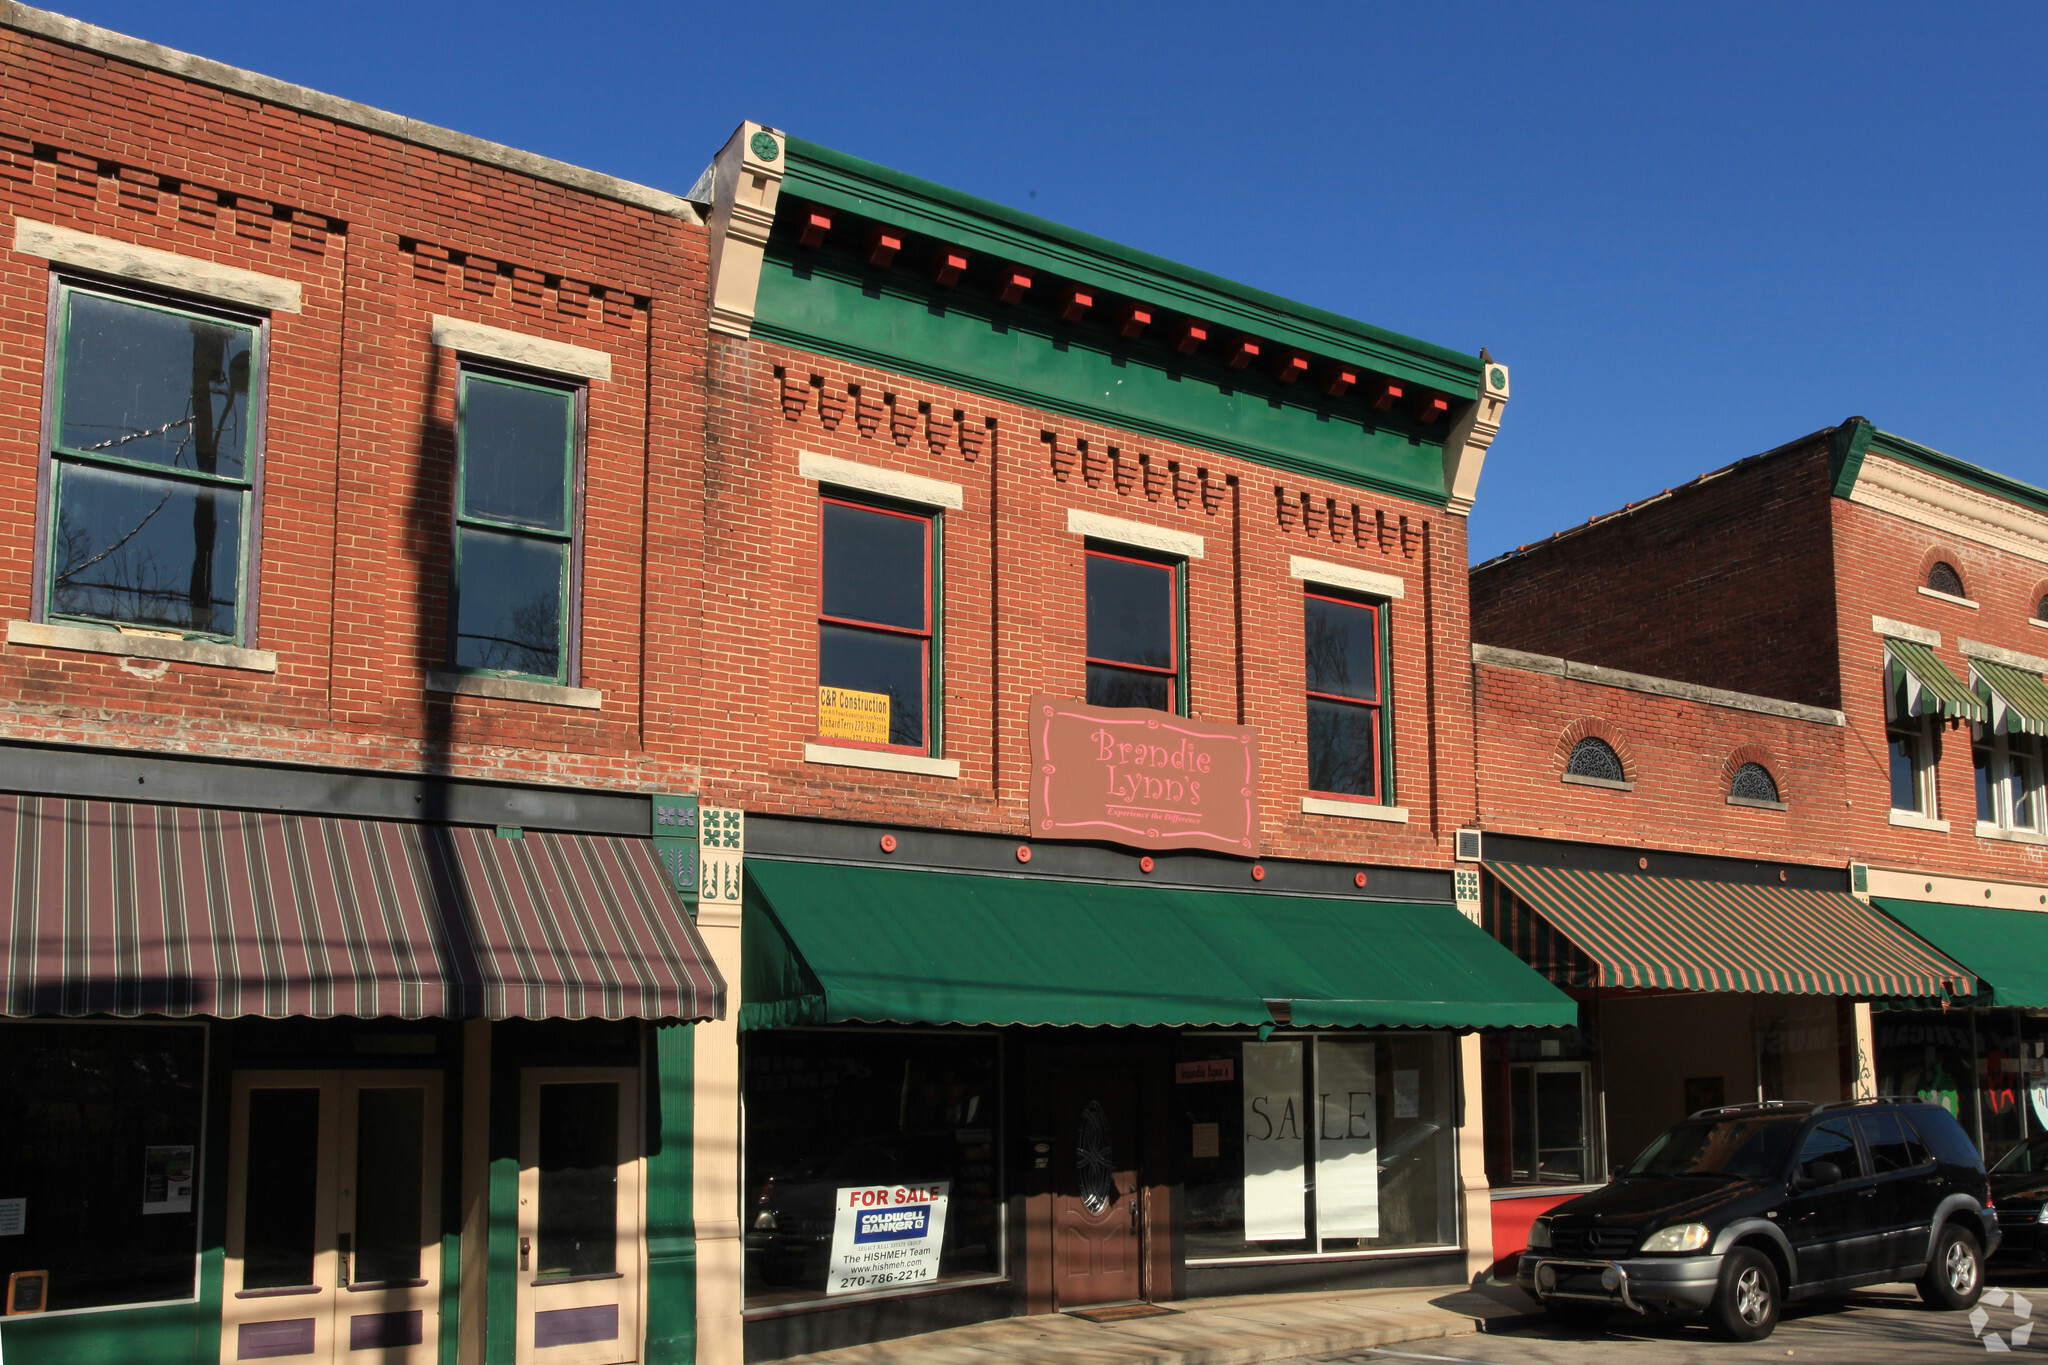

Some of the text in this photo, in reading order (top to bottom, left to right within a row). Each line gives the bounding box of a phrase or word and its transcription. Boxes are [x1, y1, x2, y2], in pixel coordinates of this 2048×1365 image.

[820, 689, 887, 714] C&R Construction
[820, 716, 840, 728] Richard
[841, 718, 854, 732] Terry
[1091, 728, 1211, 774] Brandie
[1106, 765, 1201, 805] Lynn's
[1107, 808, 1201, 824] Experience the Difference
[1246, 1091, 1372, 1143] SALE
[850, 1186, 940, 1208] FOR SALE
[844, 1246, 931, 1264] The HISHMEH Team
[850, 1257, 922, 1275] www.hishmeh.com
[840, 1267, 927, 1288] 270-786-2214
